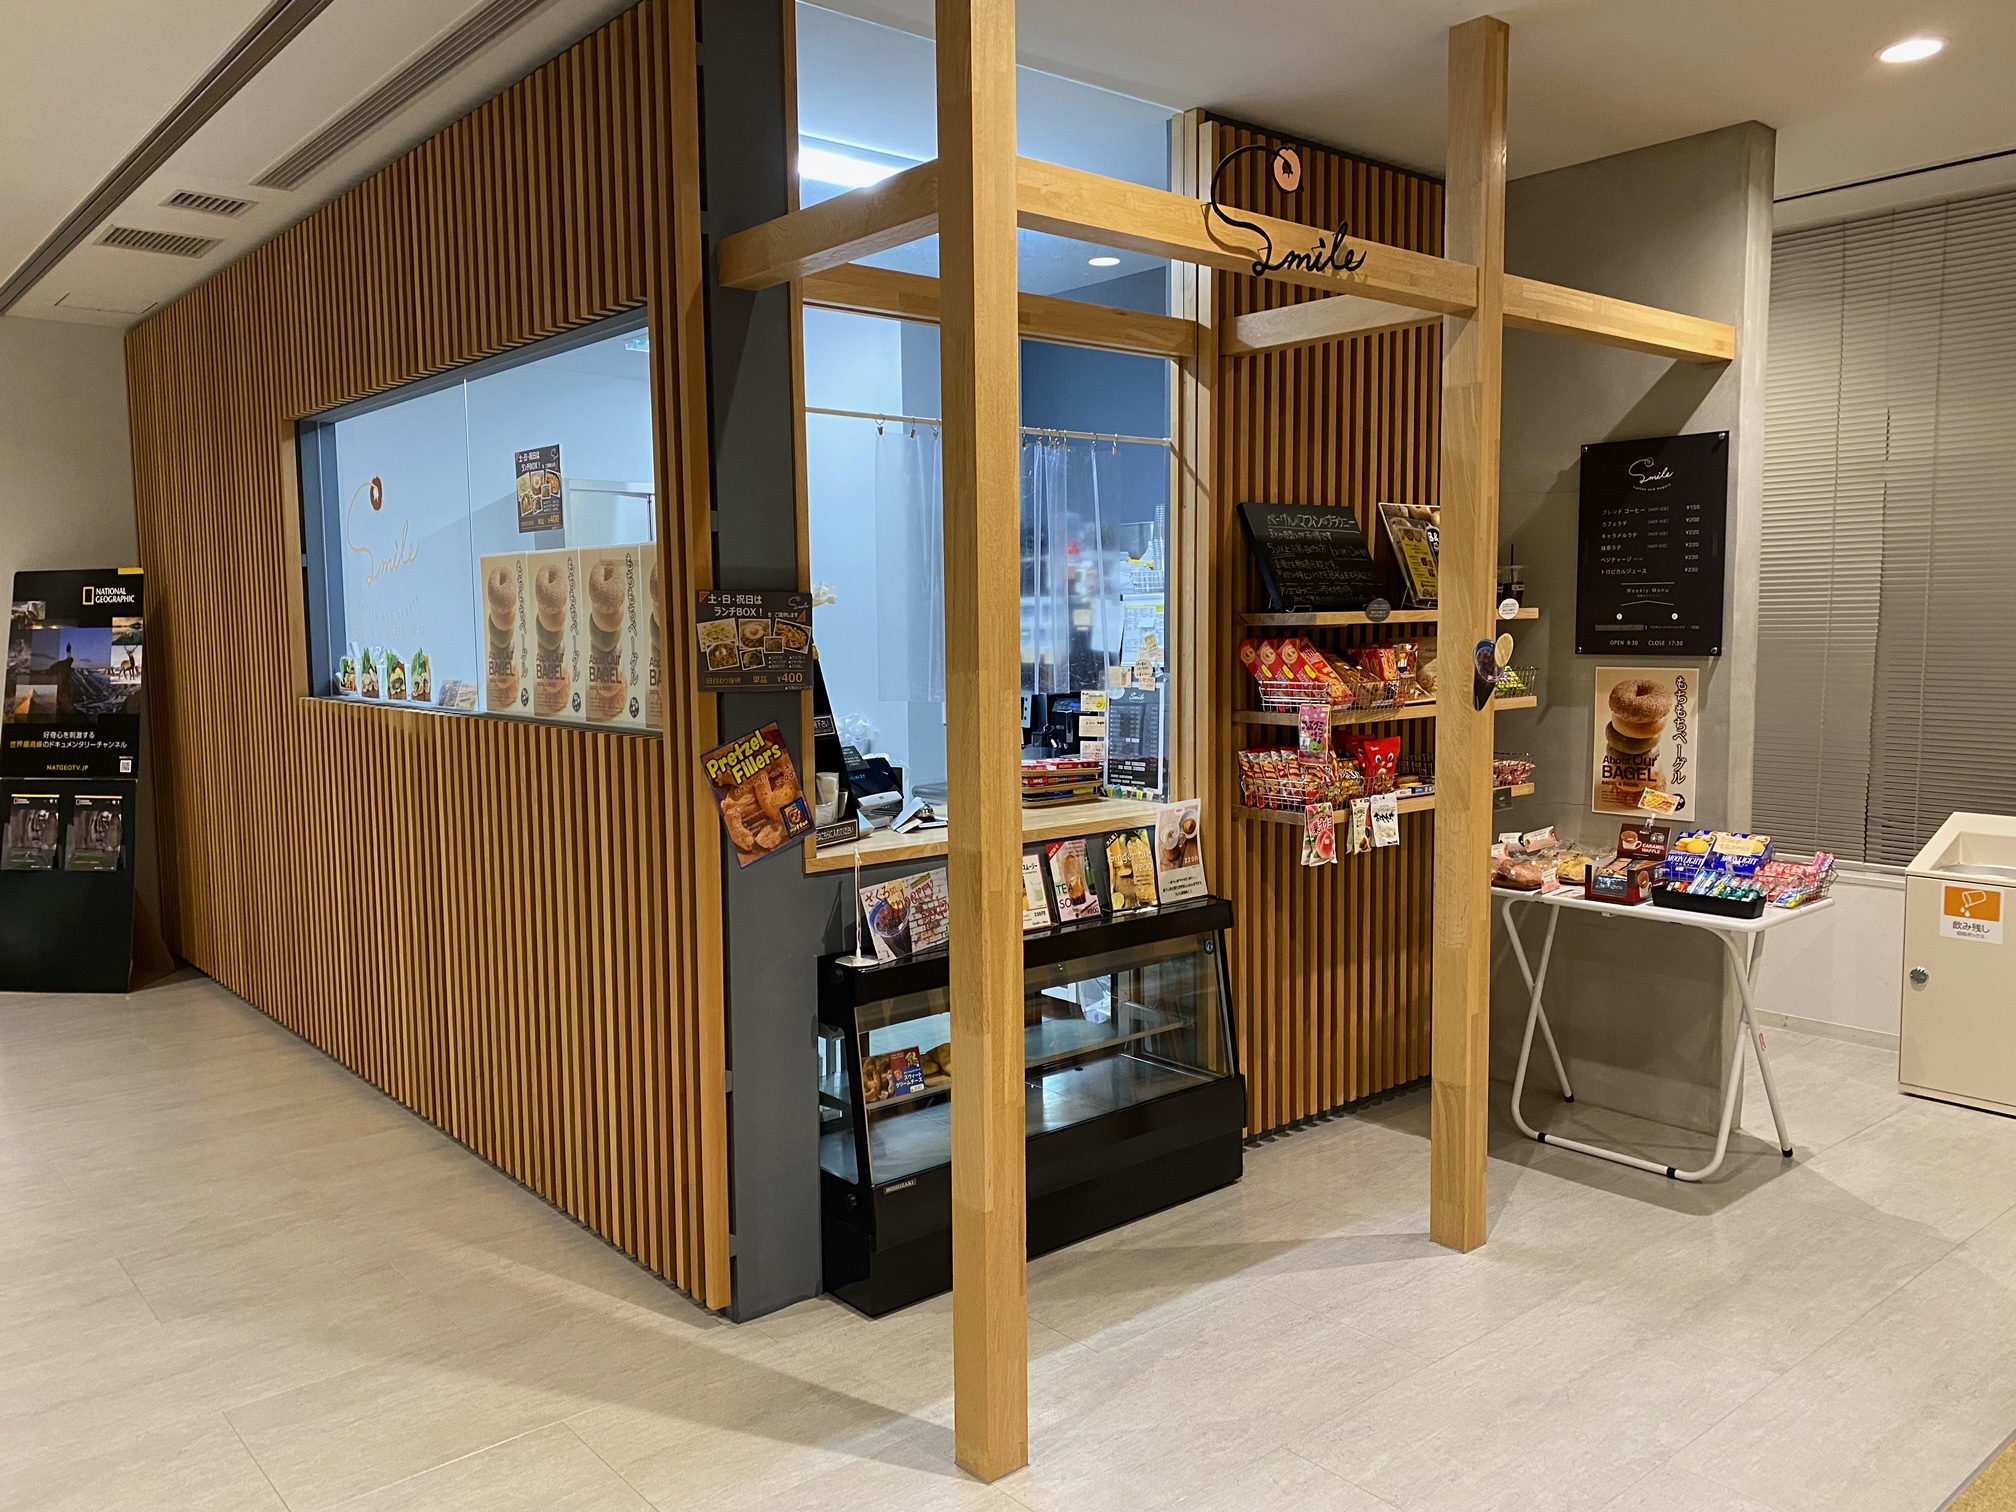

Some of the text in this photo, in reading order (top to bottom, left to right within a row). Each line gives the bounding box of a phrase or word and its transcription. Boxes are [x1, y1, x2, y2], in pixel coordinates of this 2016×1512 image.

[1211, 145, 1367, 277] Smile
[1629, 457, 1673, 484] Smile
[347, 475, 421, 587] Smile
[1602, 520, 1628, 528] カフェラテ
[96, 586, 127, 596] NATIONAL
[95, 594, 135, 604] GEOGRAPHIC
[708, 594, 762, 605] 土・日・祝日は
[516, 559, 529, 680] もちもちベーグル
[566, 556, 580, 682] もちもちベーグル
[624, 552, 640, 687] もちもちベーグル
[488, 650, 514, 661] About Our
[536, 651, 564, 664] About Our
[589, 652, 622, 666] About Our
[488, 661, 516, 678] BAGEL
[536, 664, 566, 682] BAGEL
[589, 667, 623, 684] BAGEL
[752, 676, 768, 684] 単品
[777, 672, 803, 683] ¥400
[43, 731, 95, 740] 好奇心を刺激する
[1671, 675, 1688, 785] もちもちベーグル
[10, 740, 128, 750] 世界最高峰のドキュメンタリーチャンネル
[706, 729, 766, 780] Pretzel
[1602, 754, 1658, 766] About Our
[46, 764, 89, 772] NATGEOTV.JP
[732, 744, 782, 785] Fillers
[1602, 765, 1658, 782] BAGEL
[1109, 850, 1152, 864] Ginger ale
[1134, 862, 1154, 872] ¥200
[1056, 884, 1074, 895] TEA
[1952, 920, 1990, 934] 飲み残し
[1956, 931, 1985, 939] 回収ボックス
[886, 1180, 914, 1193] HOSHIZAKI
